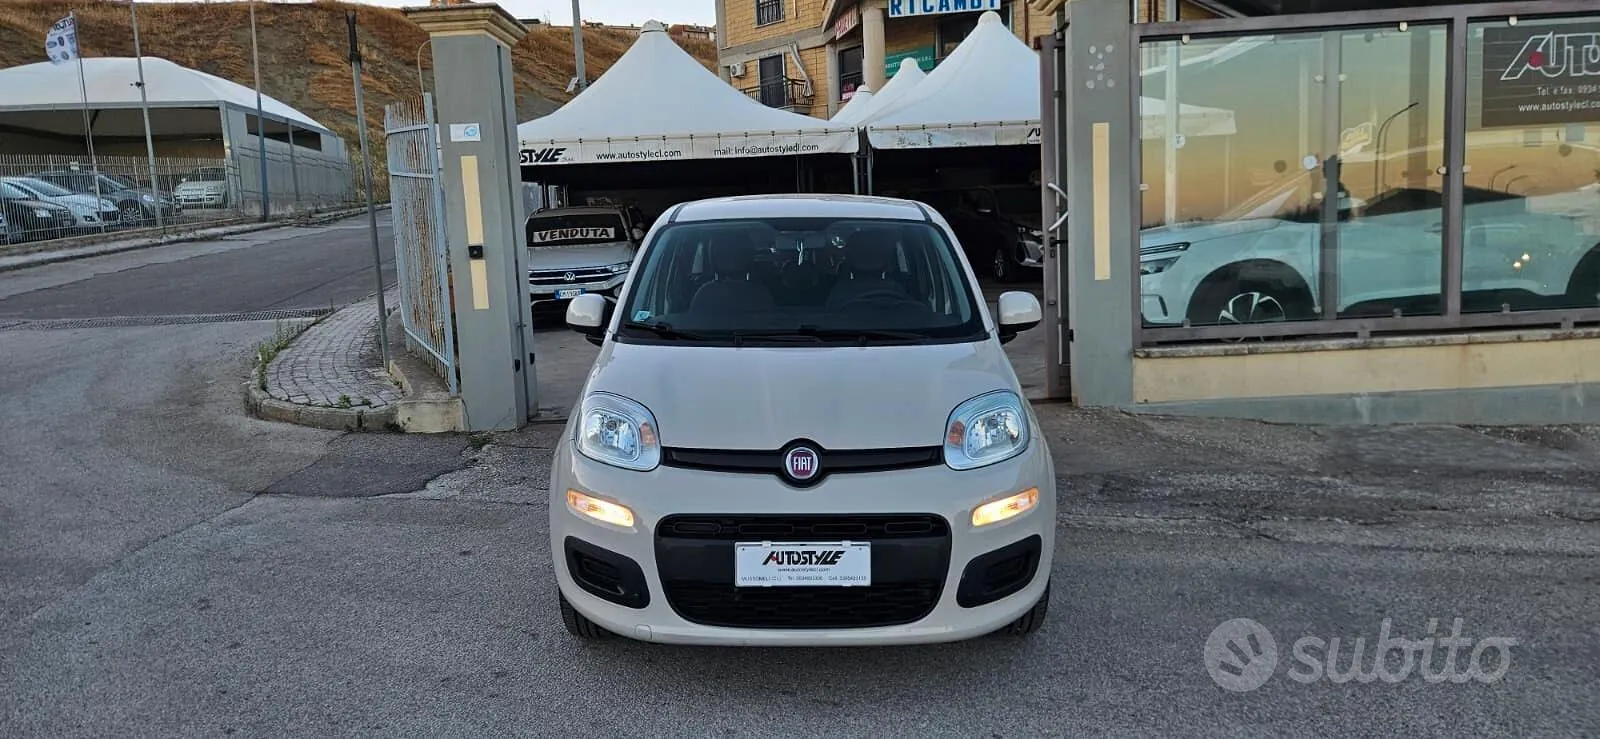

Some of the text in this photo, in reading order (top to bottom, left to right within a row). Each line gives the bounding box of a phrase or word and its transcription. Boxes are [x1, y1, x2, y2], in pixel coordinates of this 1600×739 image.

[538, 228, 610, 241] VENDUTA
[793, 456, 812, 471] FIAT
[762, 550, 846, 566] AUTOSTYLE
